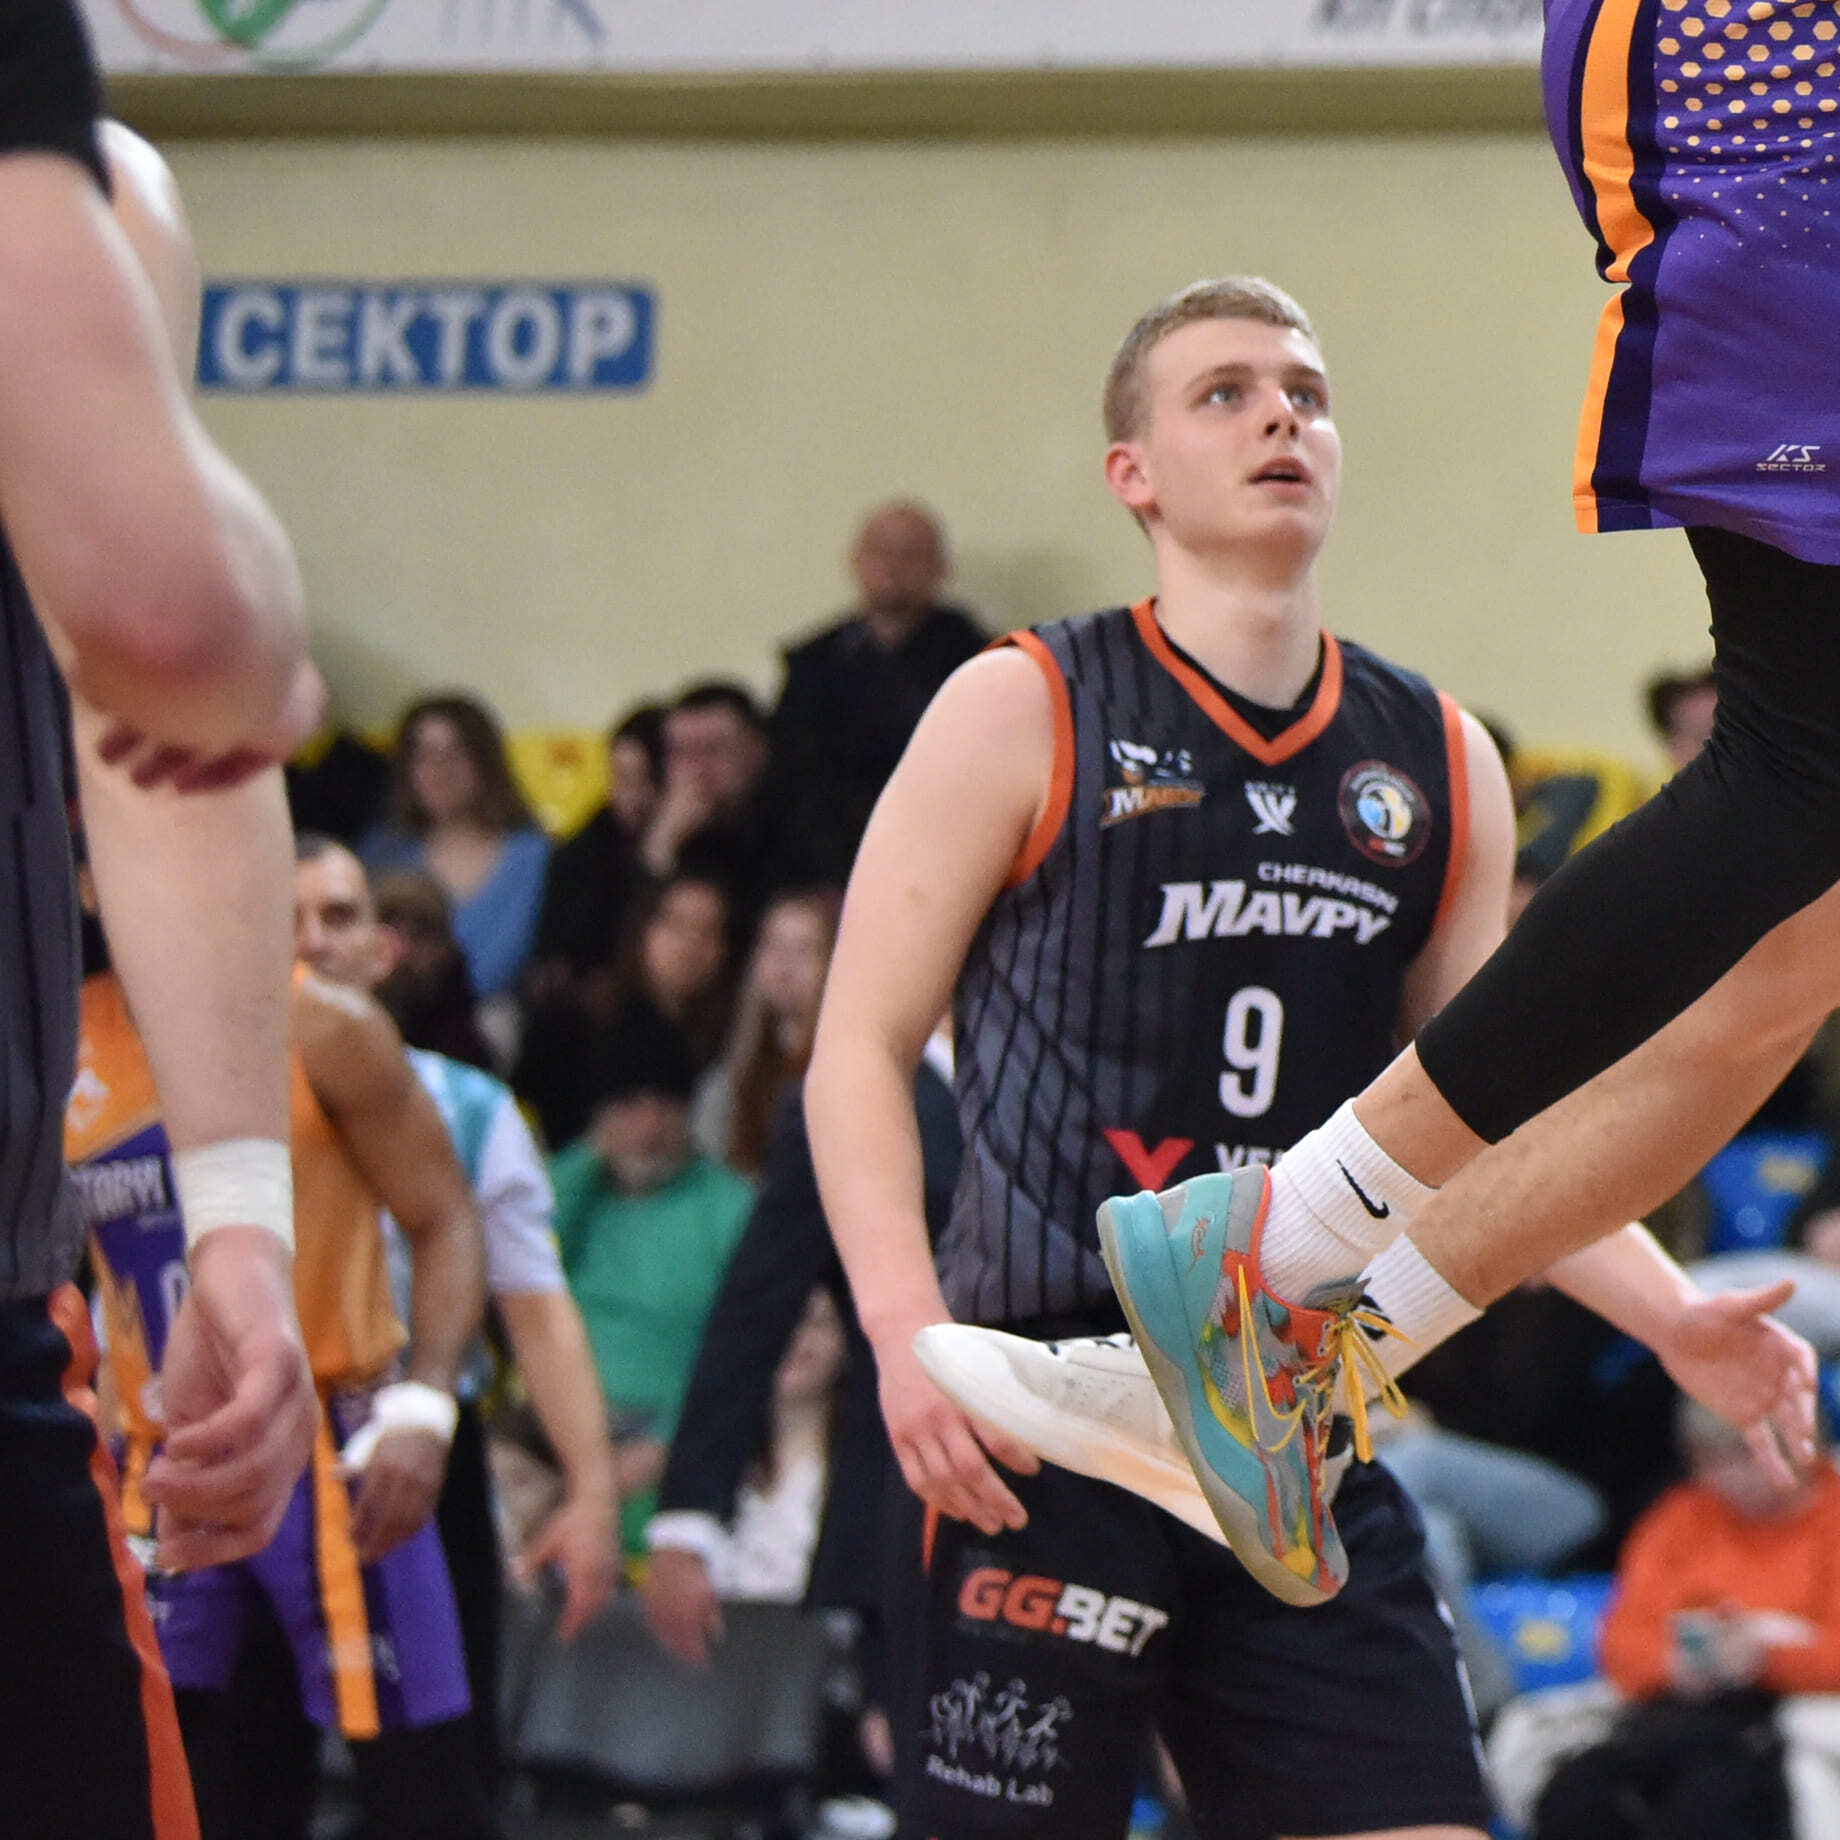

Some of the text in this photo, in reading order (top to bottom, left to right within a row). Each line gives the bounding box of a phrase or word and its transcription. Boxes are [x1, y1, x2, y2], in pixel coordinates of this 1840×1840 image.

[214, 288, 638, 385] СЕКТОР
[1143, 879, 1392, 949] MAVPY
[1218, 985, 1285, 1119] 9
[957, 1565, 1170, 1658] GG.BET
